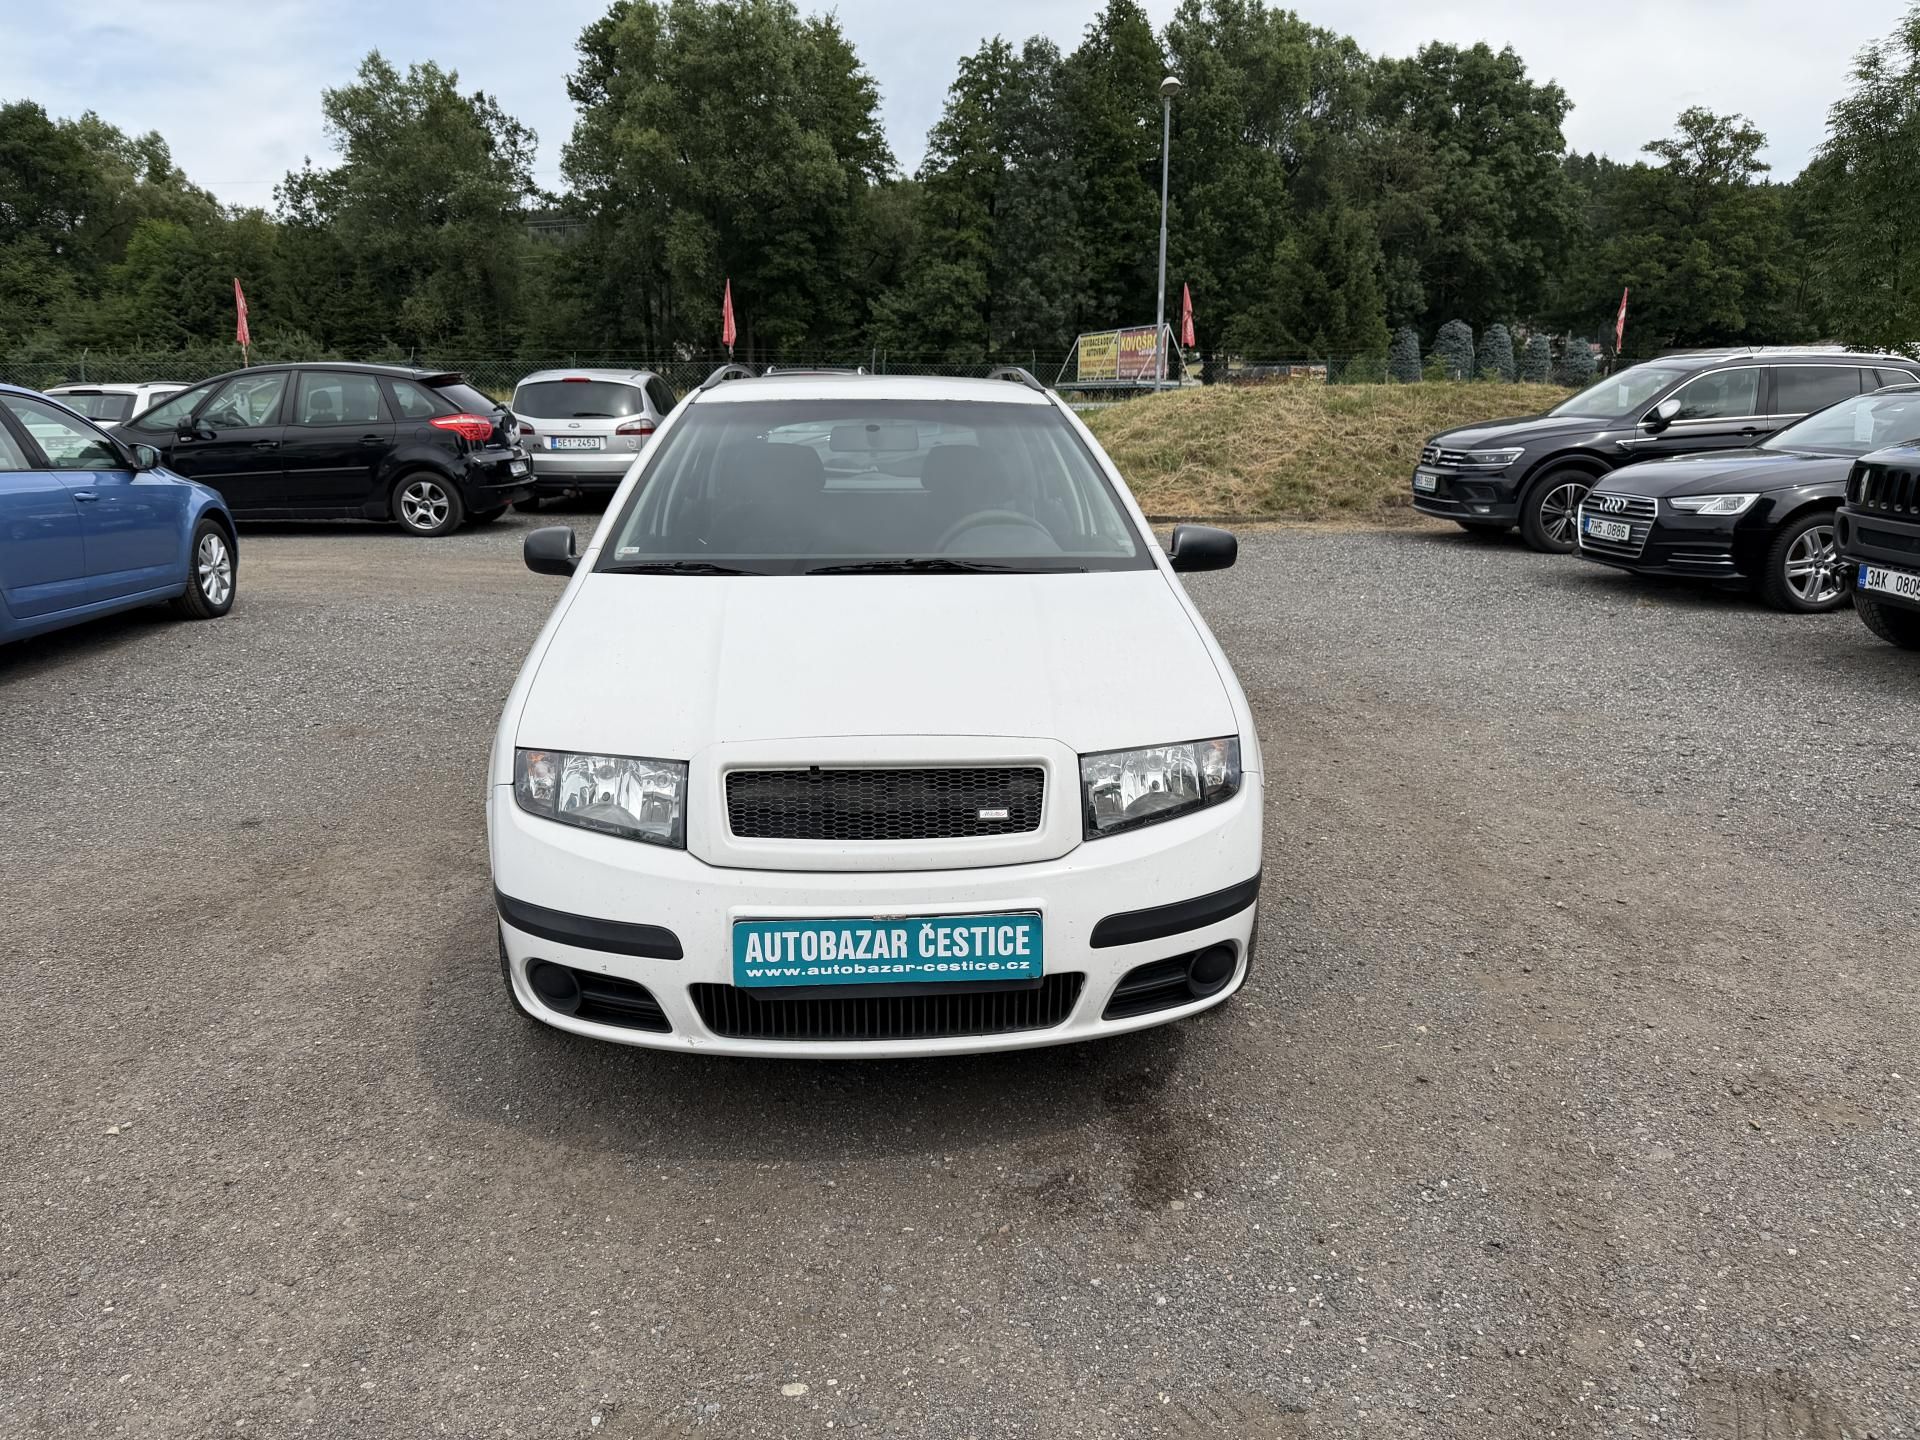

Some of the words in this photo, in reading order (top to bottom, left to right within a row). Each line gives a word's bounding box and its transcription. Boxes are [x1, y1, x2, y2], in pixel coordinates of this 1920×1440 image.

[558, 439, 572, 447] 5E1
[1590, 520, 1603, 533] 7H5
[1607, 523, 1626, 538] 0886
[1867, 569, 1888, 589] 3AK
[745, 929, 908, 963] AUTOBAZAR
[918, 923, 1031, 957] ČESTICE
[746, 961, 1030, 977] www.autobazar-cestice.cz
